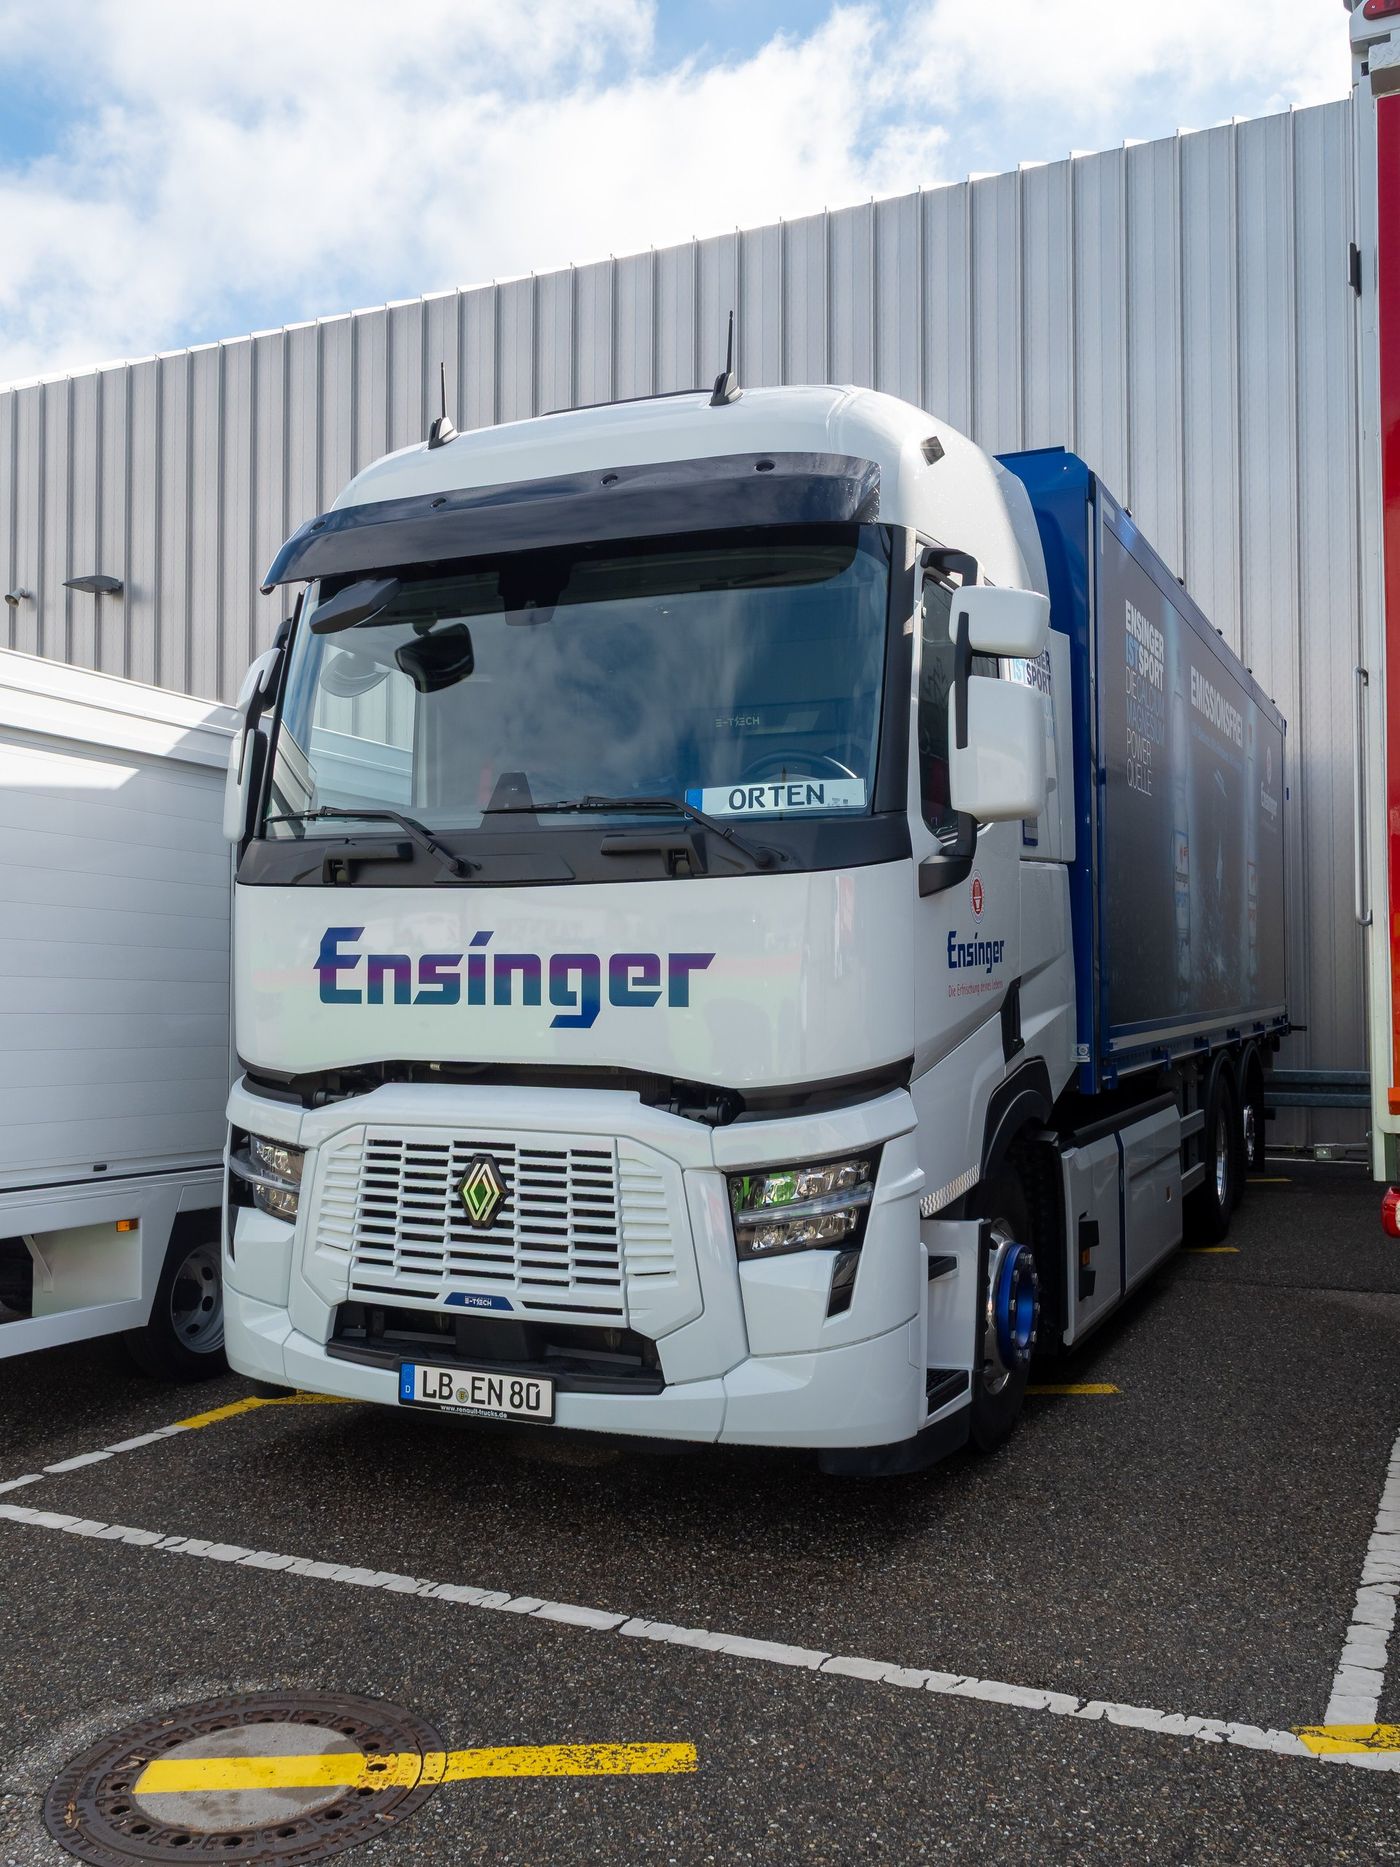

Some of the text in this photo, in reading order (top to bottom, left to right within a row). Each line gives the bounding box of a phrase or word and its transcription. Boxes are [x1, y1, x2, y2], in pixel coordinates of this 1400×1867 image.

[1125, 599, 1164, 664] ENSINGER
[1026, 662, 1051, 696] SPORT
[1125, 632, 1164, 693] IST SPORT
[715, 715, 760, 728] E-TECH
[1126, 727, 1151, 768] POWER
[728, 783, 825, 811] ORTEN
[1126, 758, 1152, 796] QUELLE
[947, 930, 1005, 974] Ensinger
[313, 926, 717, 1029] Ensinger
[405, 1370, 541, 1411] D LB EN 80
[440, 1404, 508, 1419] www.renault-trucks.de
